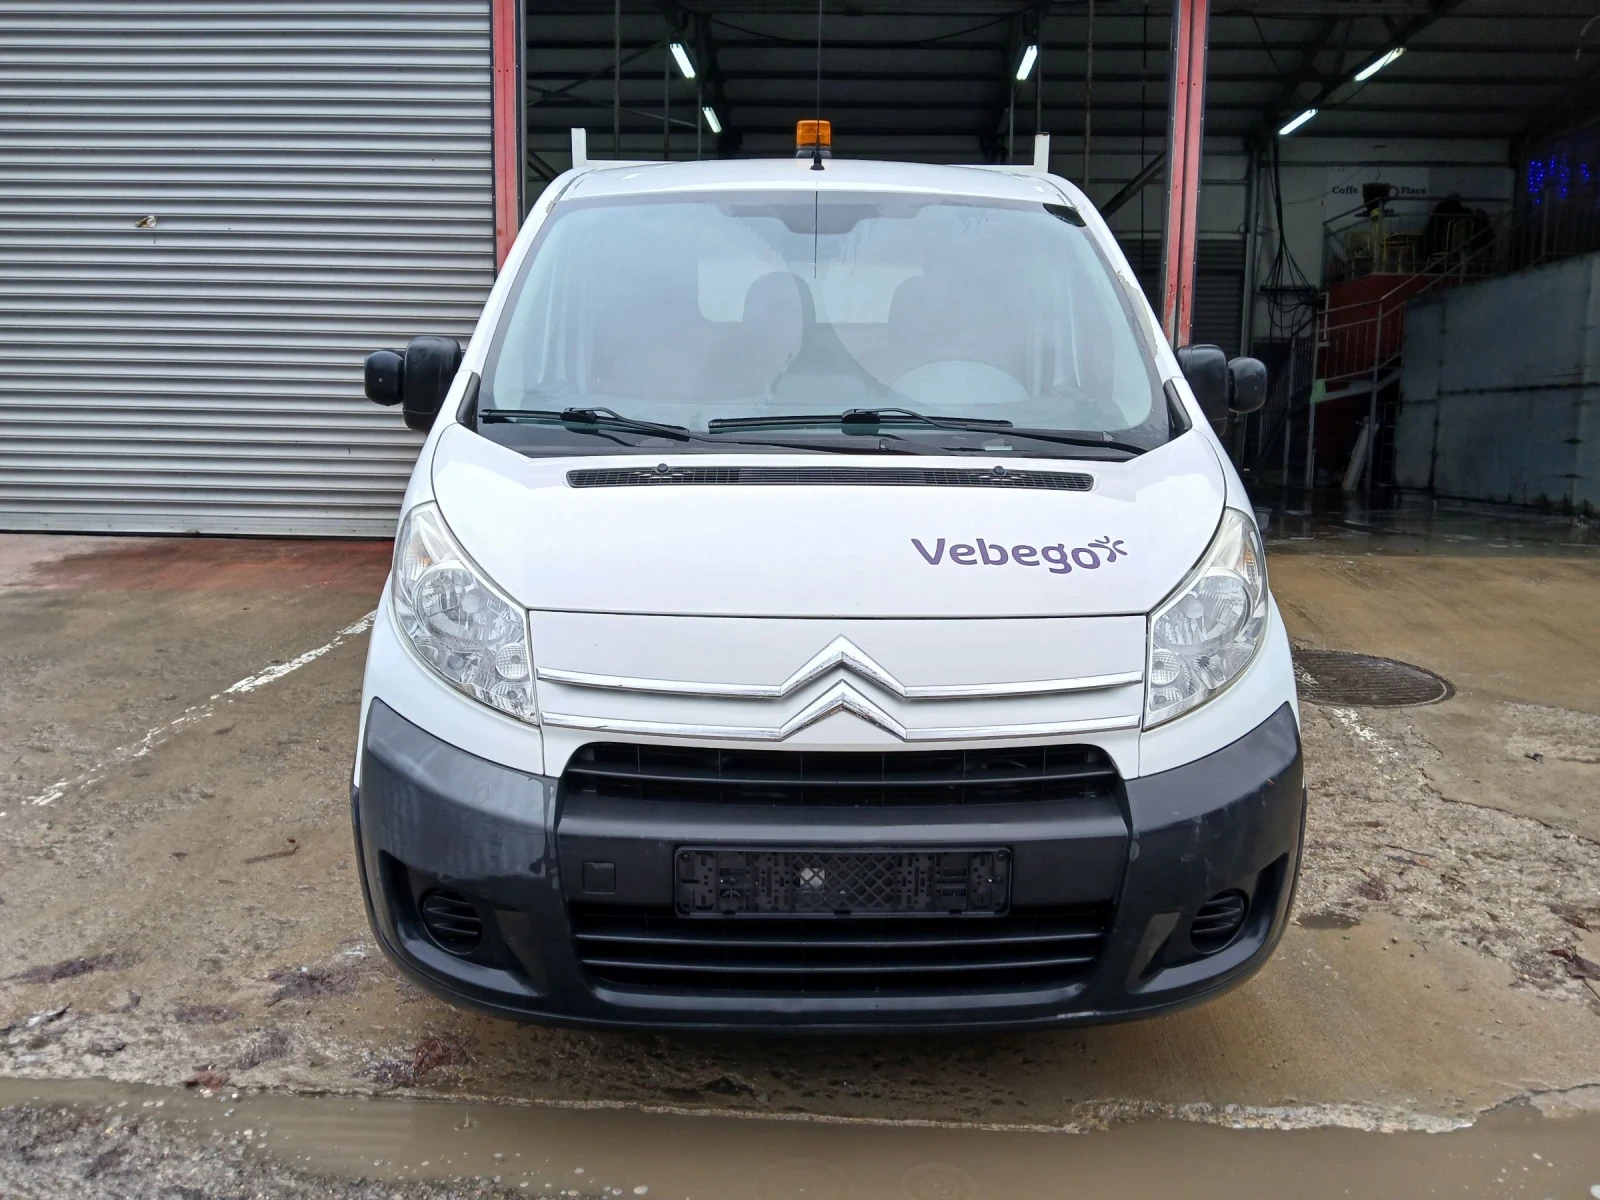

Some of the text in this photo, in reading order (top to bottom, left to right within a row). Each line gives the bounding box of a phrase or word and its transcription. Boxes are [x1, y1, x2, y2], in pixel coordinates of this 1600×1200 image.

[1332, 185, 1427, 195] Coffe Place
[910, 538, 1101, 575] Vebego
